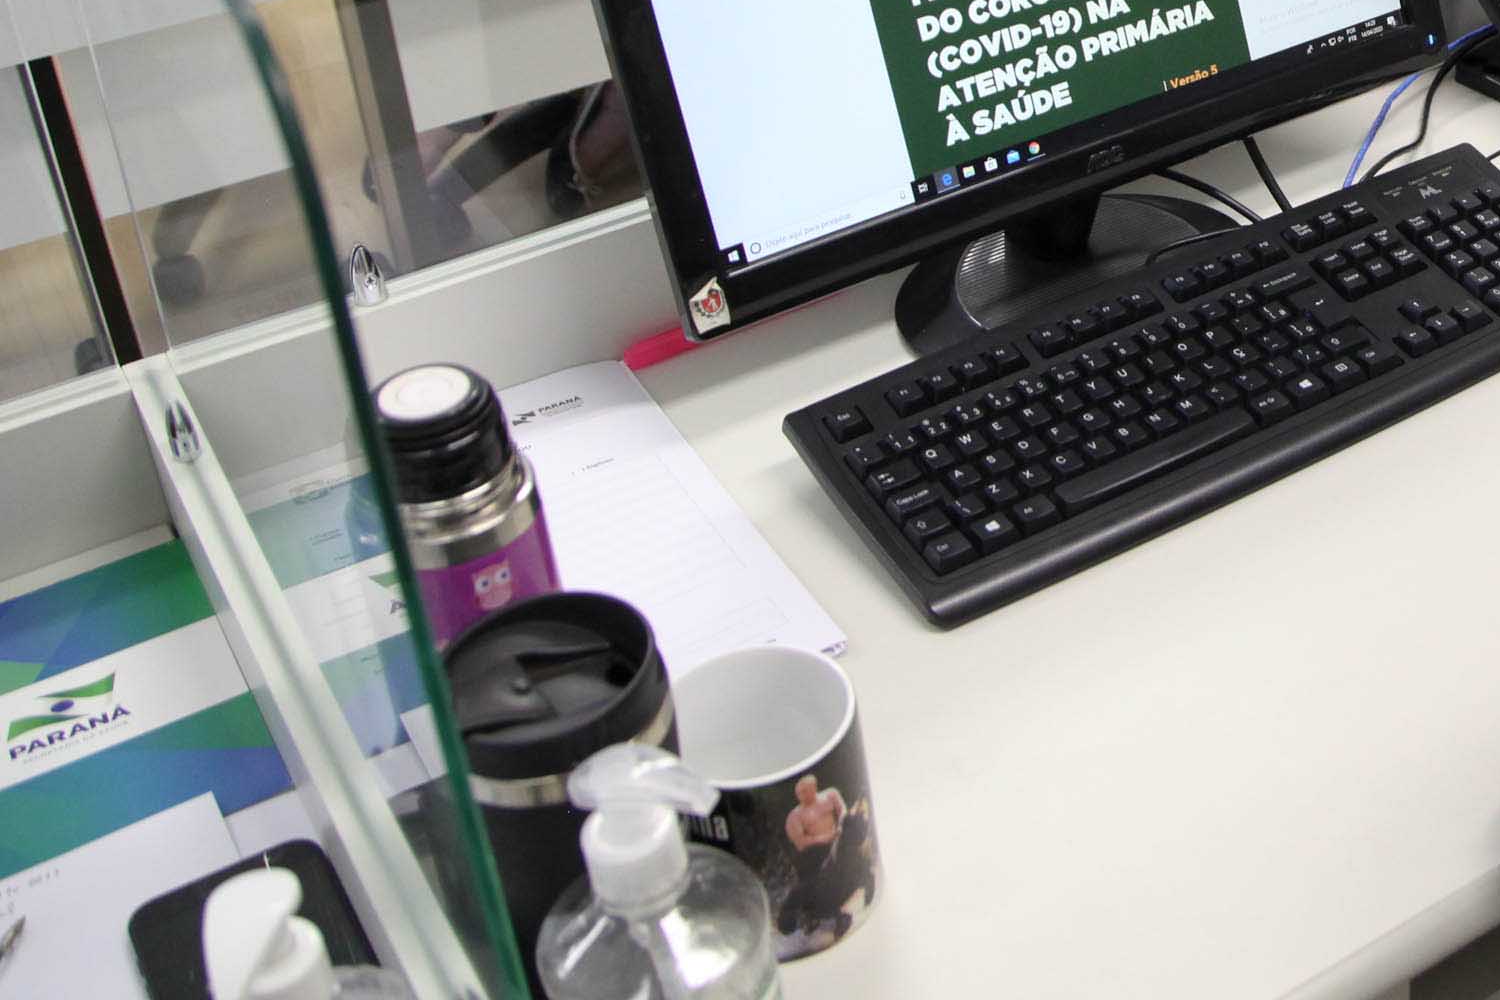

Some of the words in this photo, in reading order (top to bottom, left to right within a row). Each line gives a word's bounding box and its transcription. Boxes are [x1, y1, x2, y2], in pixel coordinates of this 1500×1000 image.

[917, 8, 963, 42] DO
[927, 8, 1083, 78] (COVID-19)
[937, 44, 1077, 112] ATENÇÃO
[1081, 0, 1215, 62] PRIMÁRIA
[946, 114, 970, 147] À
[972, 81, 1073, 136] SAÚDE
[1169, 67, 1209, 89] Versão
[1210, 64, 1218, 76] 5
[954, 468, 965, 479] A
[1113, 399, 1126, 410] H
[1173, 373, 1186, 384] K
[958, 433, 973, 446] W
[991, 421, 1003, 432] E
[1023, 406, 1035, 418] R
[1055, 393, 1065, 405] T
[1087, 380, 1098, 392] Y
[1116, 368, 1128, 379] U
[1206, 331, 1216, 341] P
[988, 483, 1001, 495] Z
[1022, 468, 1035, 481] X
[1055, 455, 1067, 466] C
[1179, 399, 1193, 411] M
